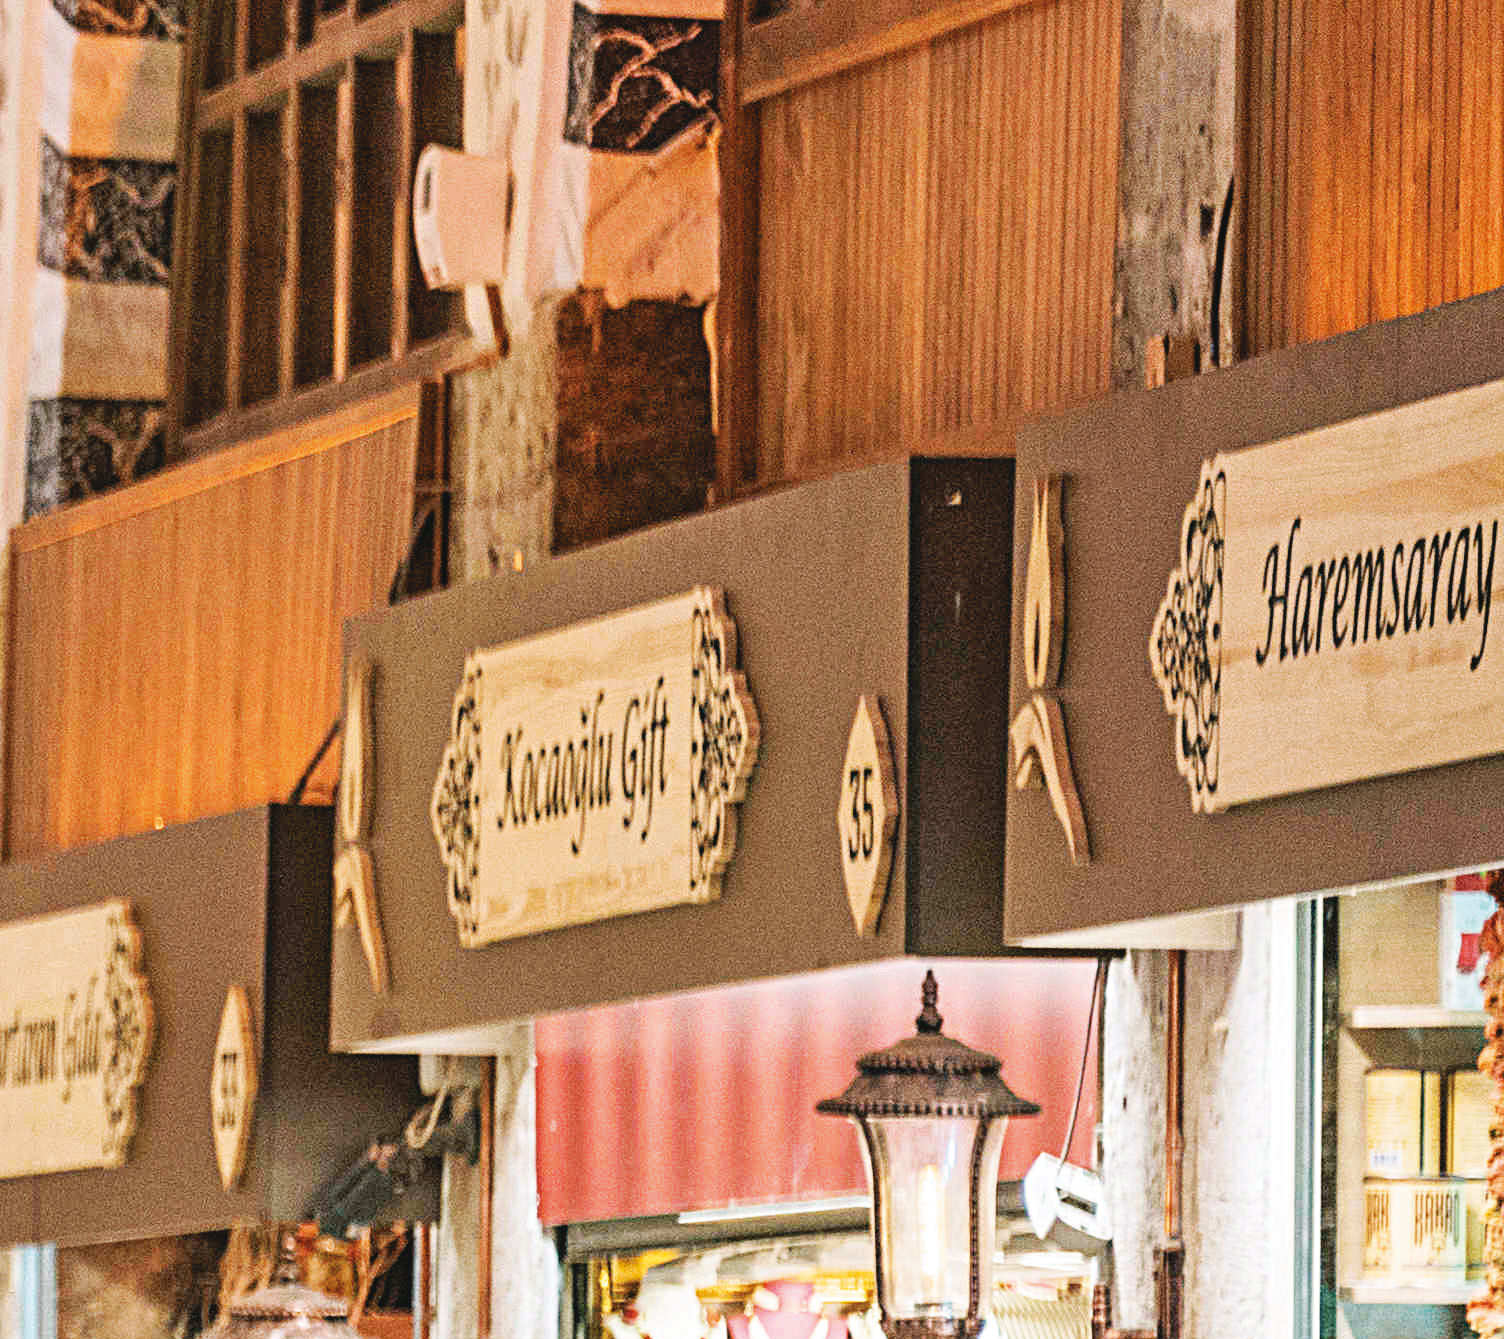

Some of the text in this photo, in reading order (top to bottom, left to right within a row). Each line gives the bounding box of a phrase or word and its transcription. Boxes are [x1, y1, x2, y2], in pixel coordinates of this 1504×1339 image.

[1255, 514, 1499, 672] Haremsaray
[497, 675, 670, 857] Kocaoğlu Gift
[848, 767, 875, 861] 35
